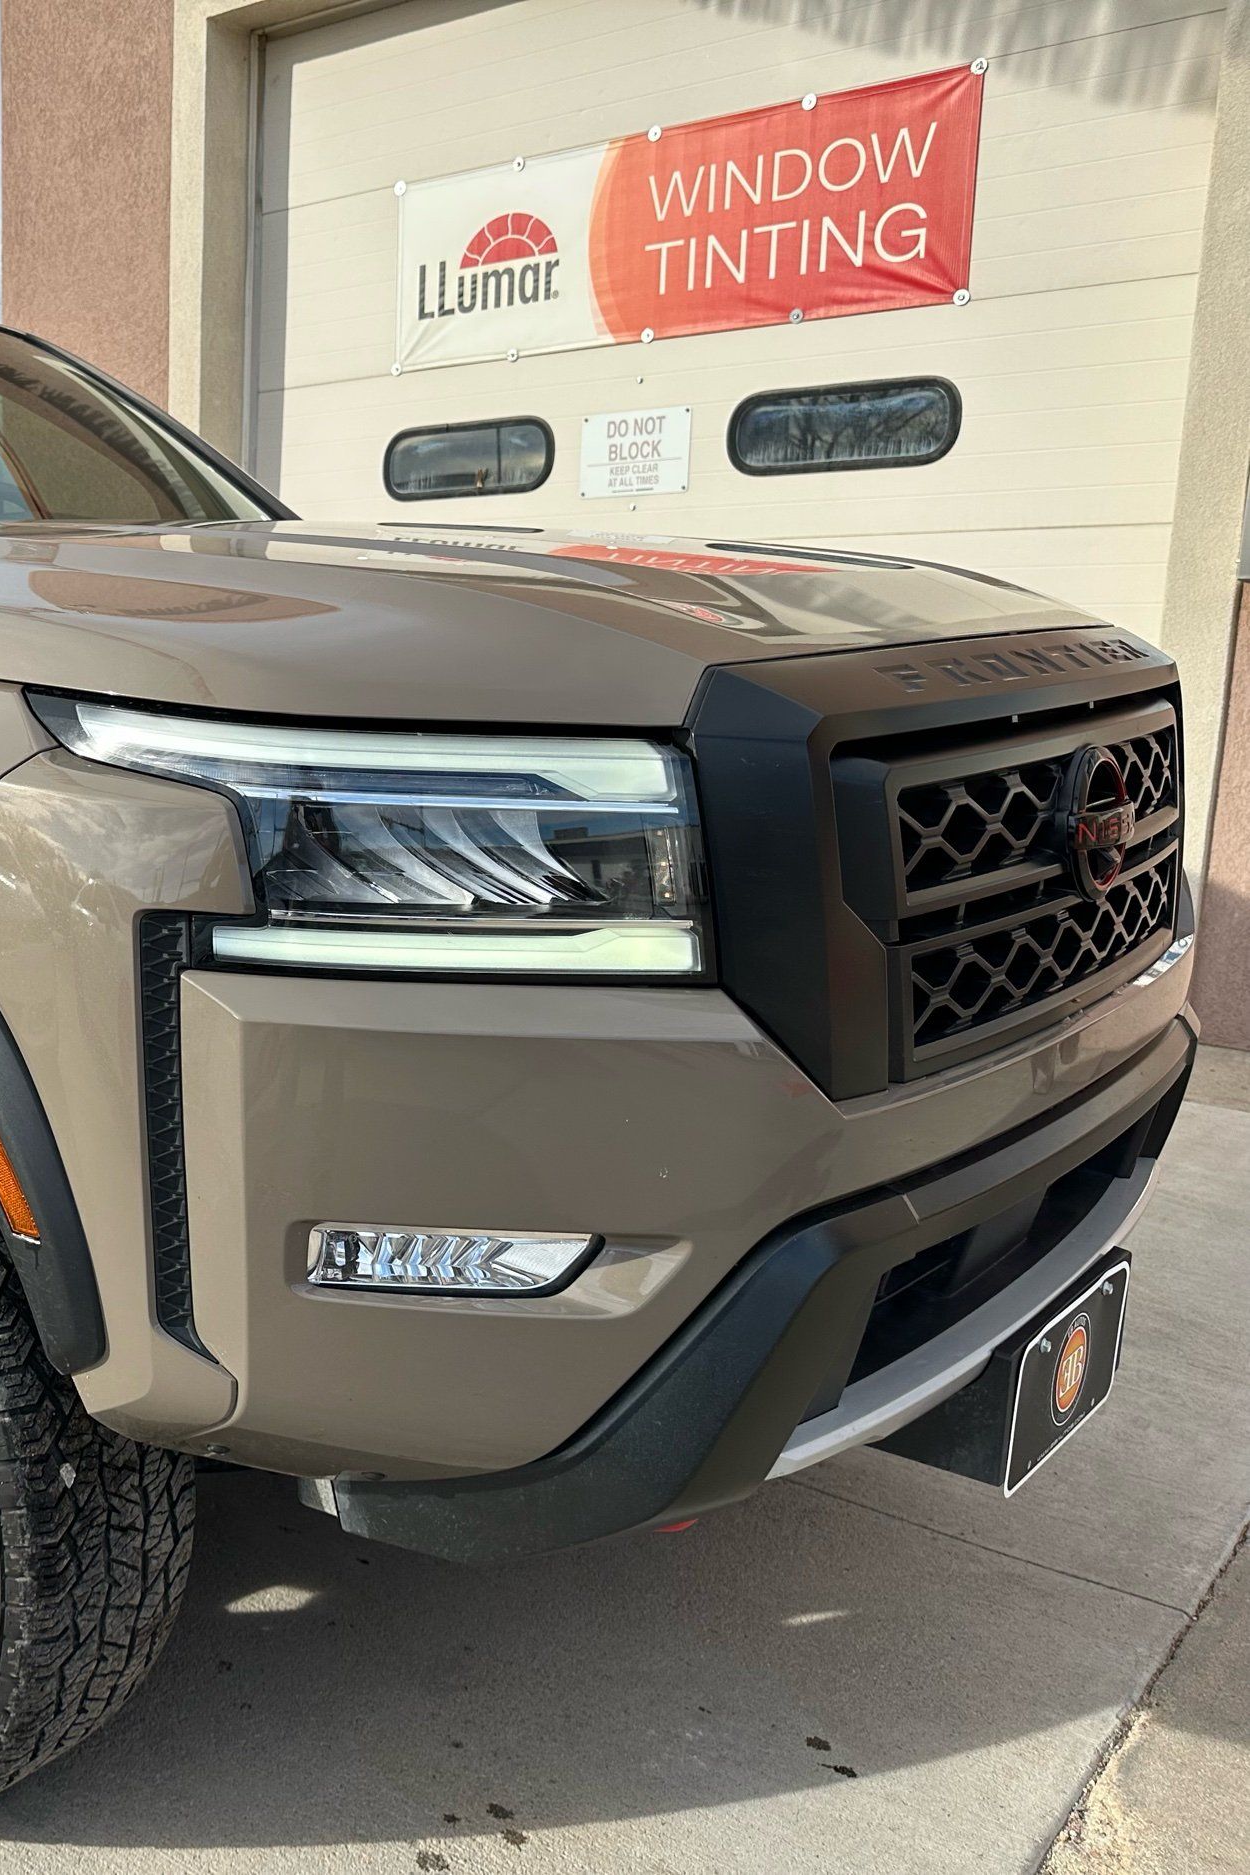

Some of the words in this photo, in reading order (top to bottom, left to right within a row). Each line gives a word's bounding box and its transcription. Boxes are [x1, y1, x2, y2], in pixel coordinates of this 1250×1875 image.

[649, 121, 937, 222] WINDOW
[644, 202, 928, 295] TINTING
[607, 419, 629, 439] DO
[633, 415, 666, 436] NOT
[608, 440, 662, 461] BLOCK
[608, 478, 618, 488] AT
[619, 477, 634, 487] ALL
[636, 475, 660, 485] TIMES
[609, 465, 630, 476] KEEP
[632, 463, 659, 475] CLEAR
[872, 639, 1151, 693] FRONTIER
